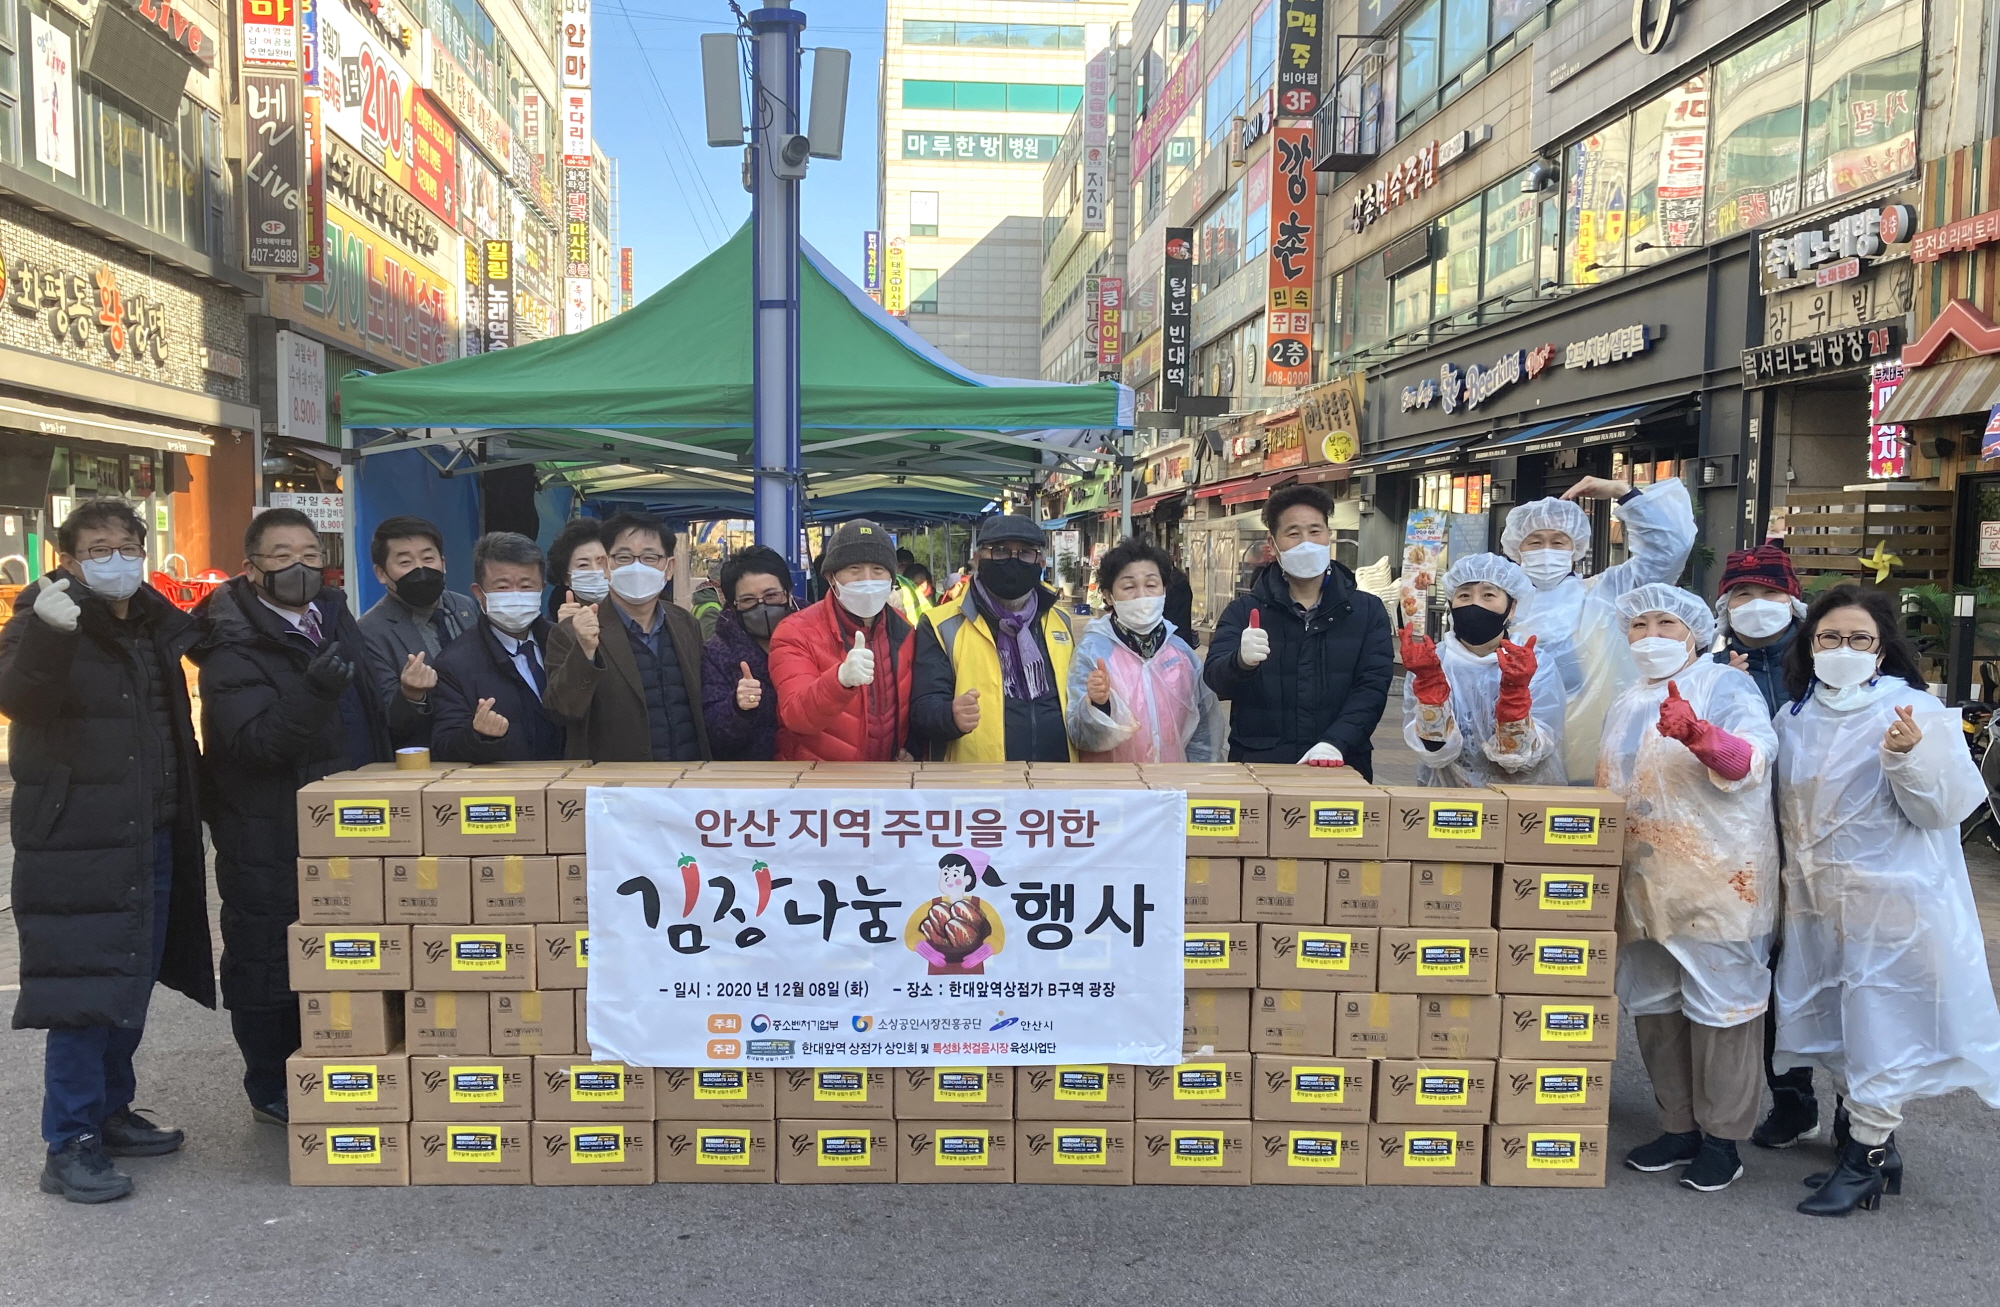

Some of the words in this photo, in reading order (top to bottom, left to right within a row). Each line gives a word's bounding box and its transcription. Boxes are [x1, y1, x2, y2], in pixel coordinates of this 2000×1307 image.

[1287, 10, 1317, 69] 맥주
[565, 24, 586, 80] 안마
[1282, 72, 1318, 85] 비어펍
[361, 46, 402, 158] 200
[1286, 90, 1311, 110] 3F
[570, 97, 584, 139] 투다리
[907, 136, 999, 156] 마루한방
[1009, 138, 1038, 159] 병원
[246, 151, 300, 210] Live
[265, 223, 281, 232] 3F
[1914, 215, 2000, 259] 퓨전요리팩토리
[569, 223, 586, 262] 마사지
[1767, 208, 1880, 279] 축제노래방
[1882, 215, 1898, 234] 3층
[251, 249, 298, 263] 407-2989
[486, 242, 508, 279] 힐링
[1818, 261, 1858, 284] 노래광장
[1273, 289, 1308, 307] 민속
[1272, 314, 1307, 332] 주점
[1273, 341, 1304, 366] 2층
[1744, 333, 1864, 380] 럭셔리노래광장
[1868, 328, 1890, 357] 2F
[1267, 371, 1309, 385] 408-0202
[1465, 350, 1521, 411] Beerking
[296, 496, 318, 506] 과일
[695, 809, 781, 848] 안산
[789, 809, 871, 848] 지역
[881, 808, 1007, 848] 주민을
[1016, 808, 1100, 848] 위한
[616, 852, 902, 954] 김장나눔
[1010, 882, 1155, 950] 행사
[674, 982, 700, 998] 일시
[717, 982, 752, 997] 2020
[756, 982, 769, 997] 년
[775, 981, 804, 997] 12월
[809, 981, 840, 997] 08일
[844, 981, 869, 998] (화)
[906, 982, 933, 998] 장소
[949, 982, 1043, 998] 한대앞역상점가
[1048, 982, 1084, 998] B구역
[1088, 982, 1116, 998] 광장
[713, 1018, 737, 1029] 주최
[772, 1020, 839, 1031] 중소벤처기업부
[877, 1018, 982, 1030] 소상공인시장진흥공단
[1020, 1020, 1054, 1031] 안산시
[713, 1044, 736, 1055] 주관
[802, 1042, 846, 1055] 한대앞역
[849, 1042, 882, 1055] 상점가
[884, 1042, 917, 1055] 상인회
[920, 1043, 929, 1054] 및
[932, 1042, 961, 1054] 특성화
[962, 1042, 1009, 1054] 첫걸음시장
[1009, 1042, 1056, 1054] 육성사업단
